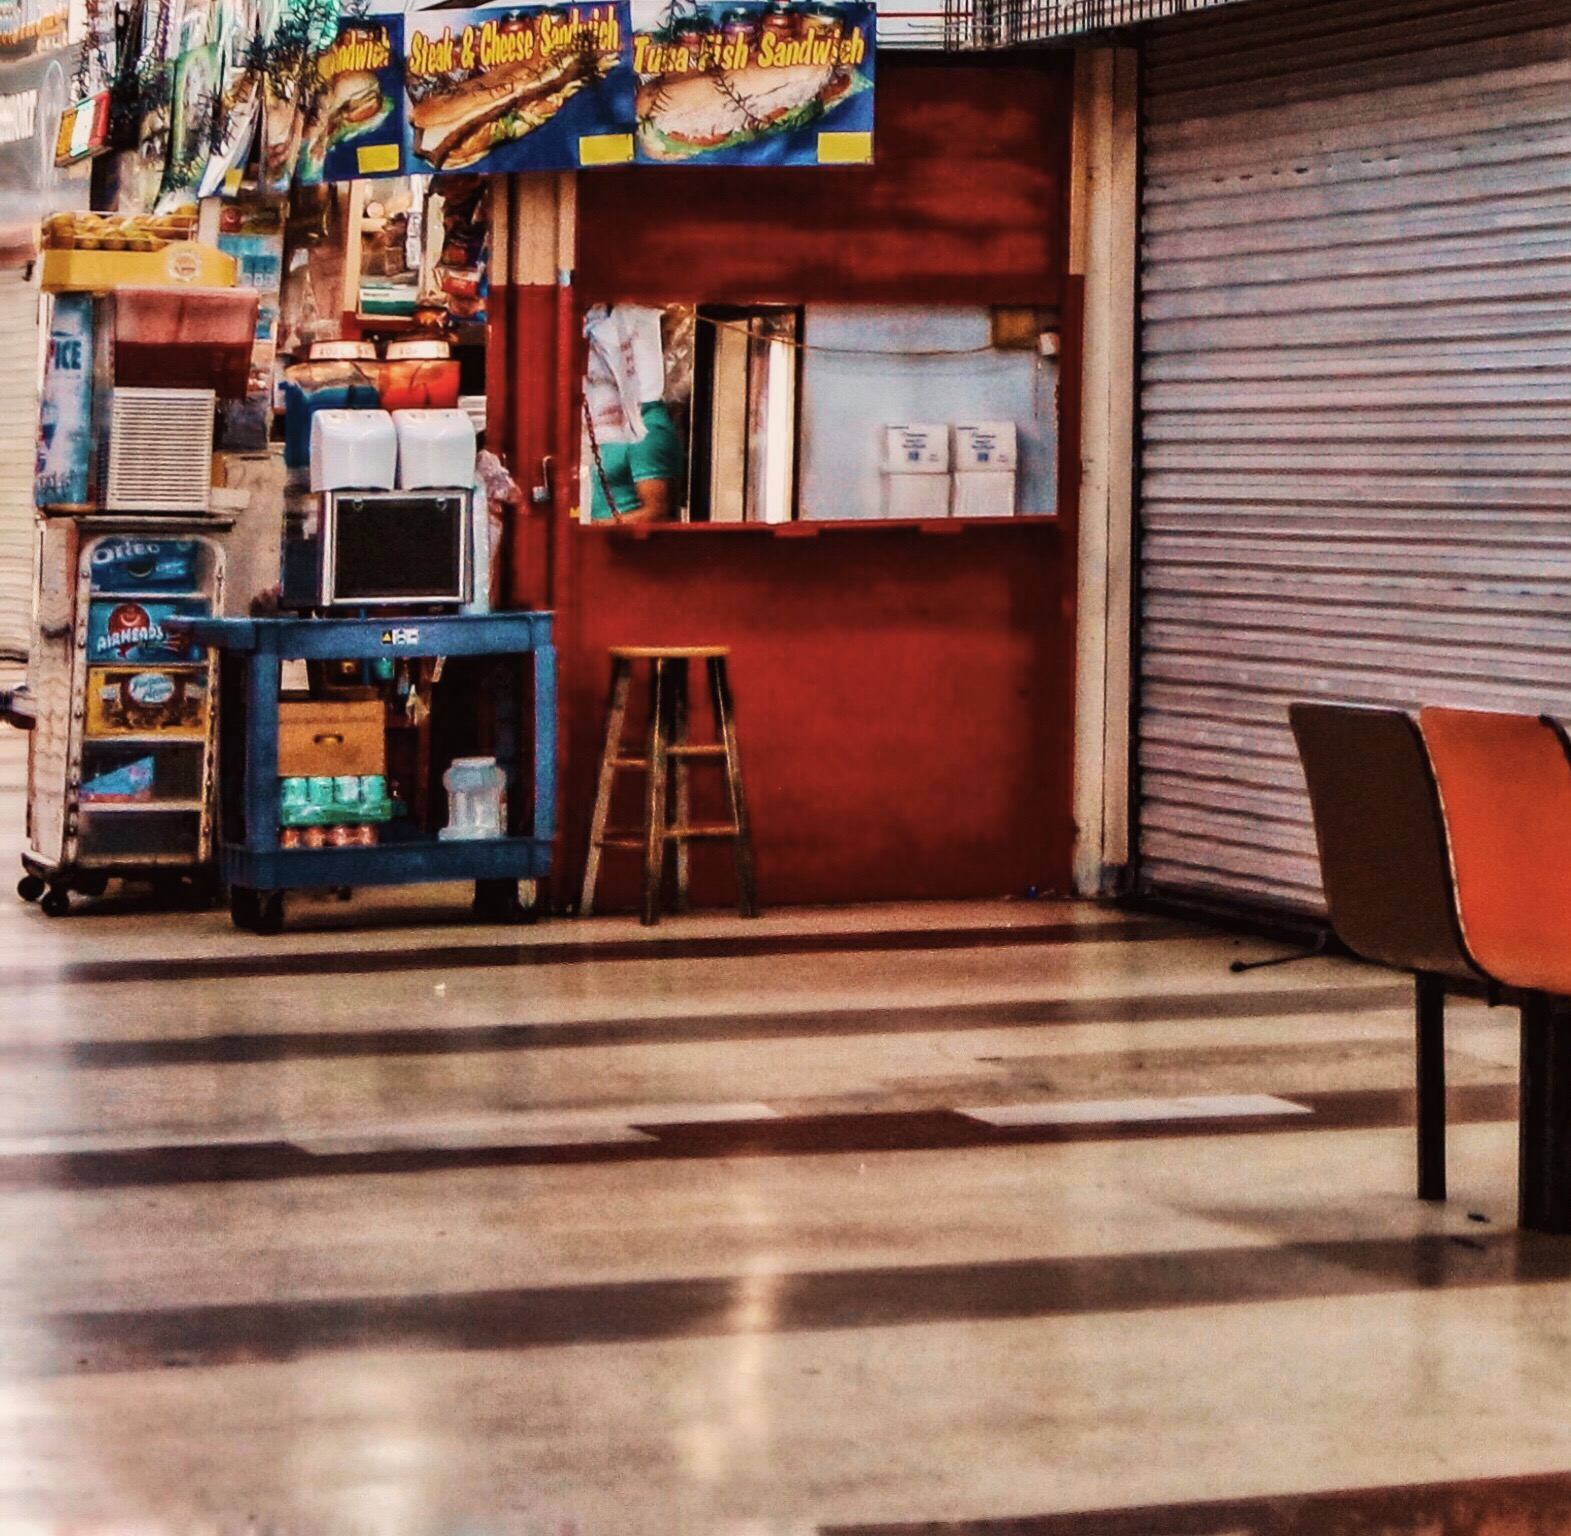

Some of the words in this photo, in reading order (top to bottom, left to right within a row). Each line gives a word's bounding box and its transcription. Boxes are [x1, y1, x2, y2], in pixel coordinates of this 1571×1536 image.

[409, 26, 453, 75] Steak
[461, 25, 475, 69] &
[480, 19, 534, 66] Cheese
[757, 26, 865, 68] Sandwich
